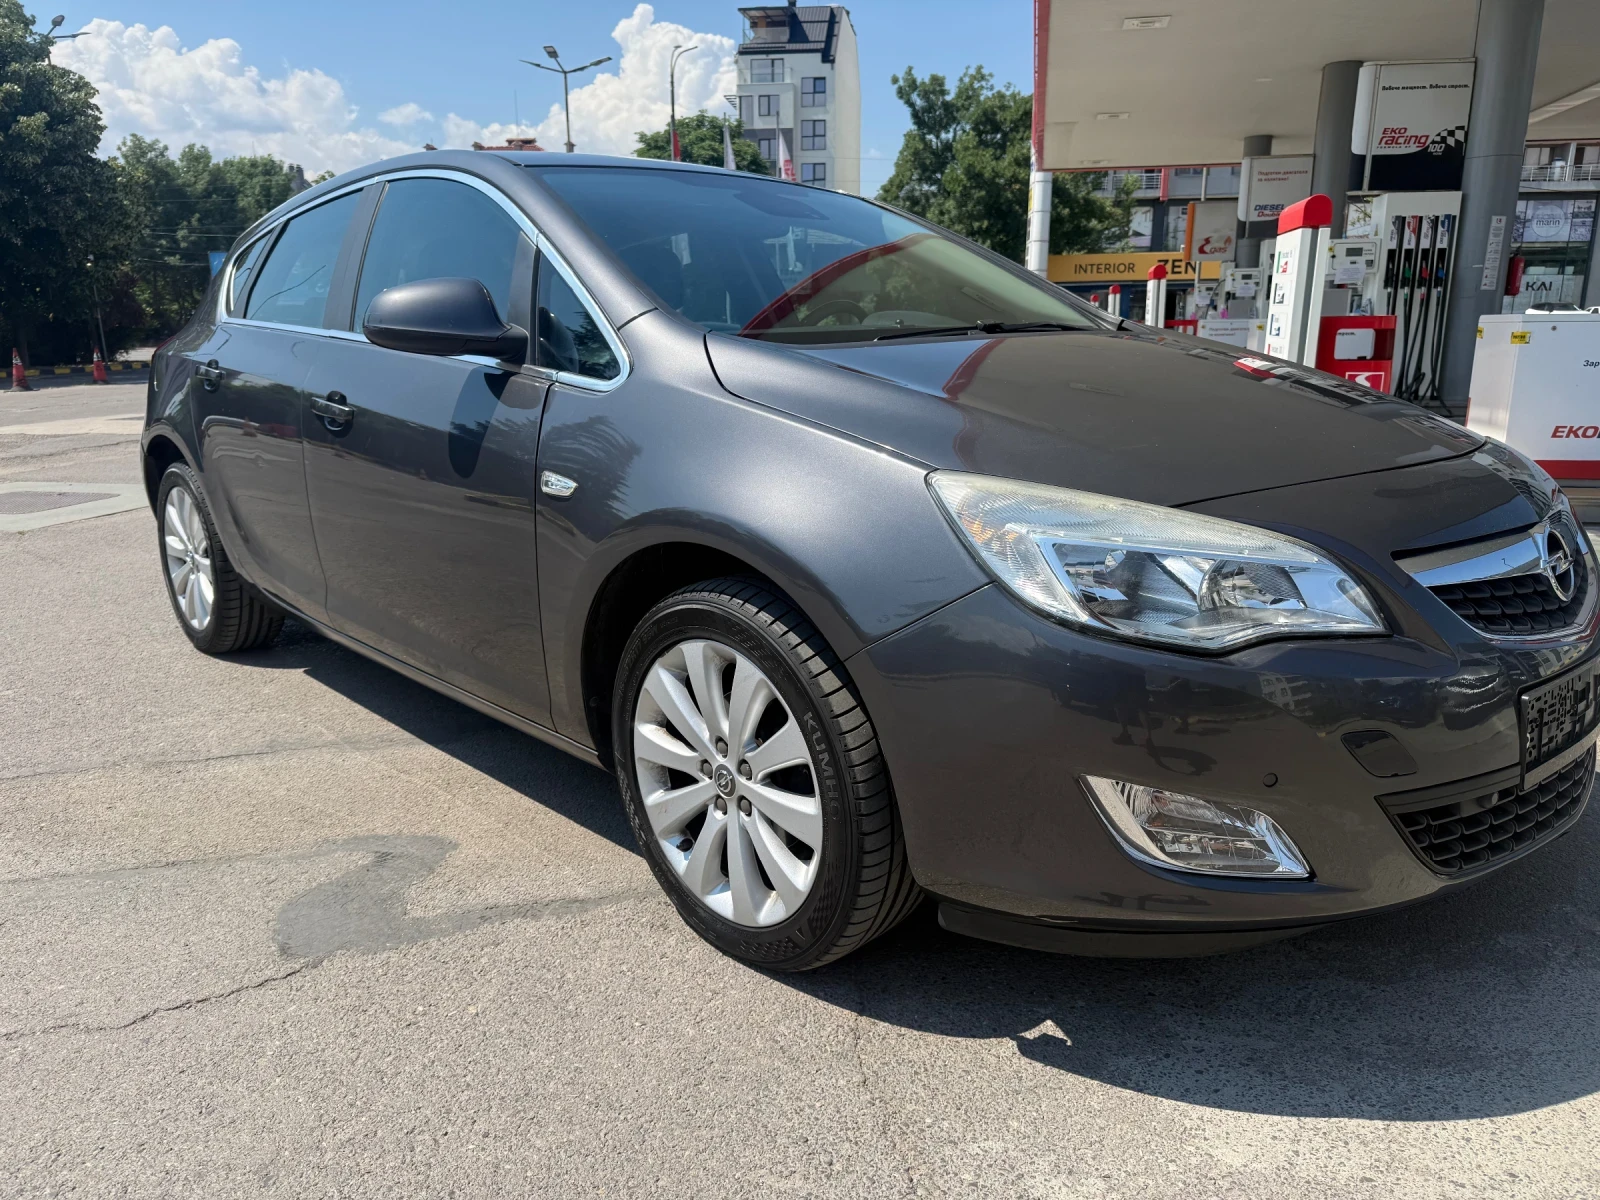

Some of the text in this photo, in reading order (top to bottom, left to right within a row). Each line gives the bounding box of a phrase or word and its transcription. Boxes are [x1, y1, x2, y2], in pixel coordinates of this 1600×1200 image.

[1378, 135, 1429, 148] racing
[1428, 144, 1445, 152] 100
[1074, 263, 1135, 274] INTERIOR
[1551, 426, 1600, 438] EKO
[803, 710, 841, 822] KUMHO
